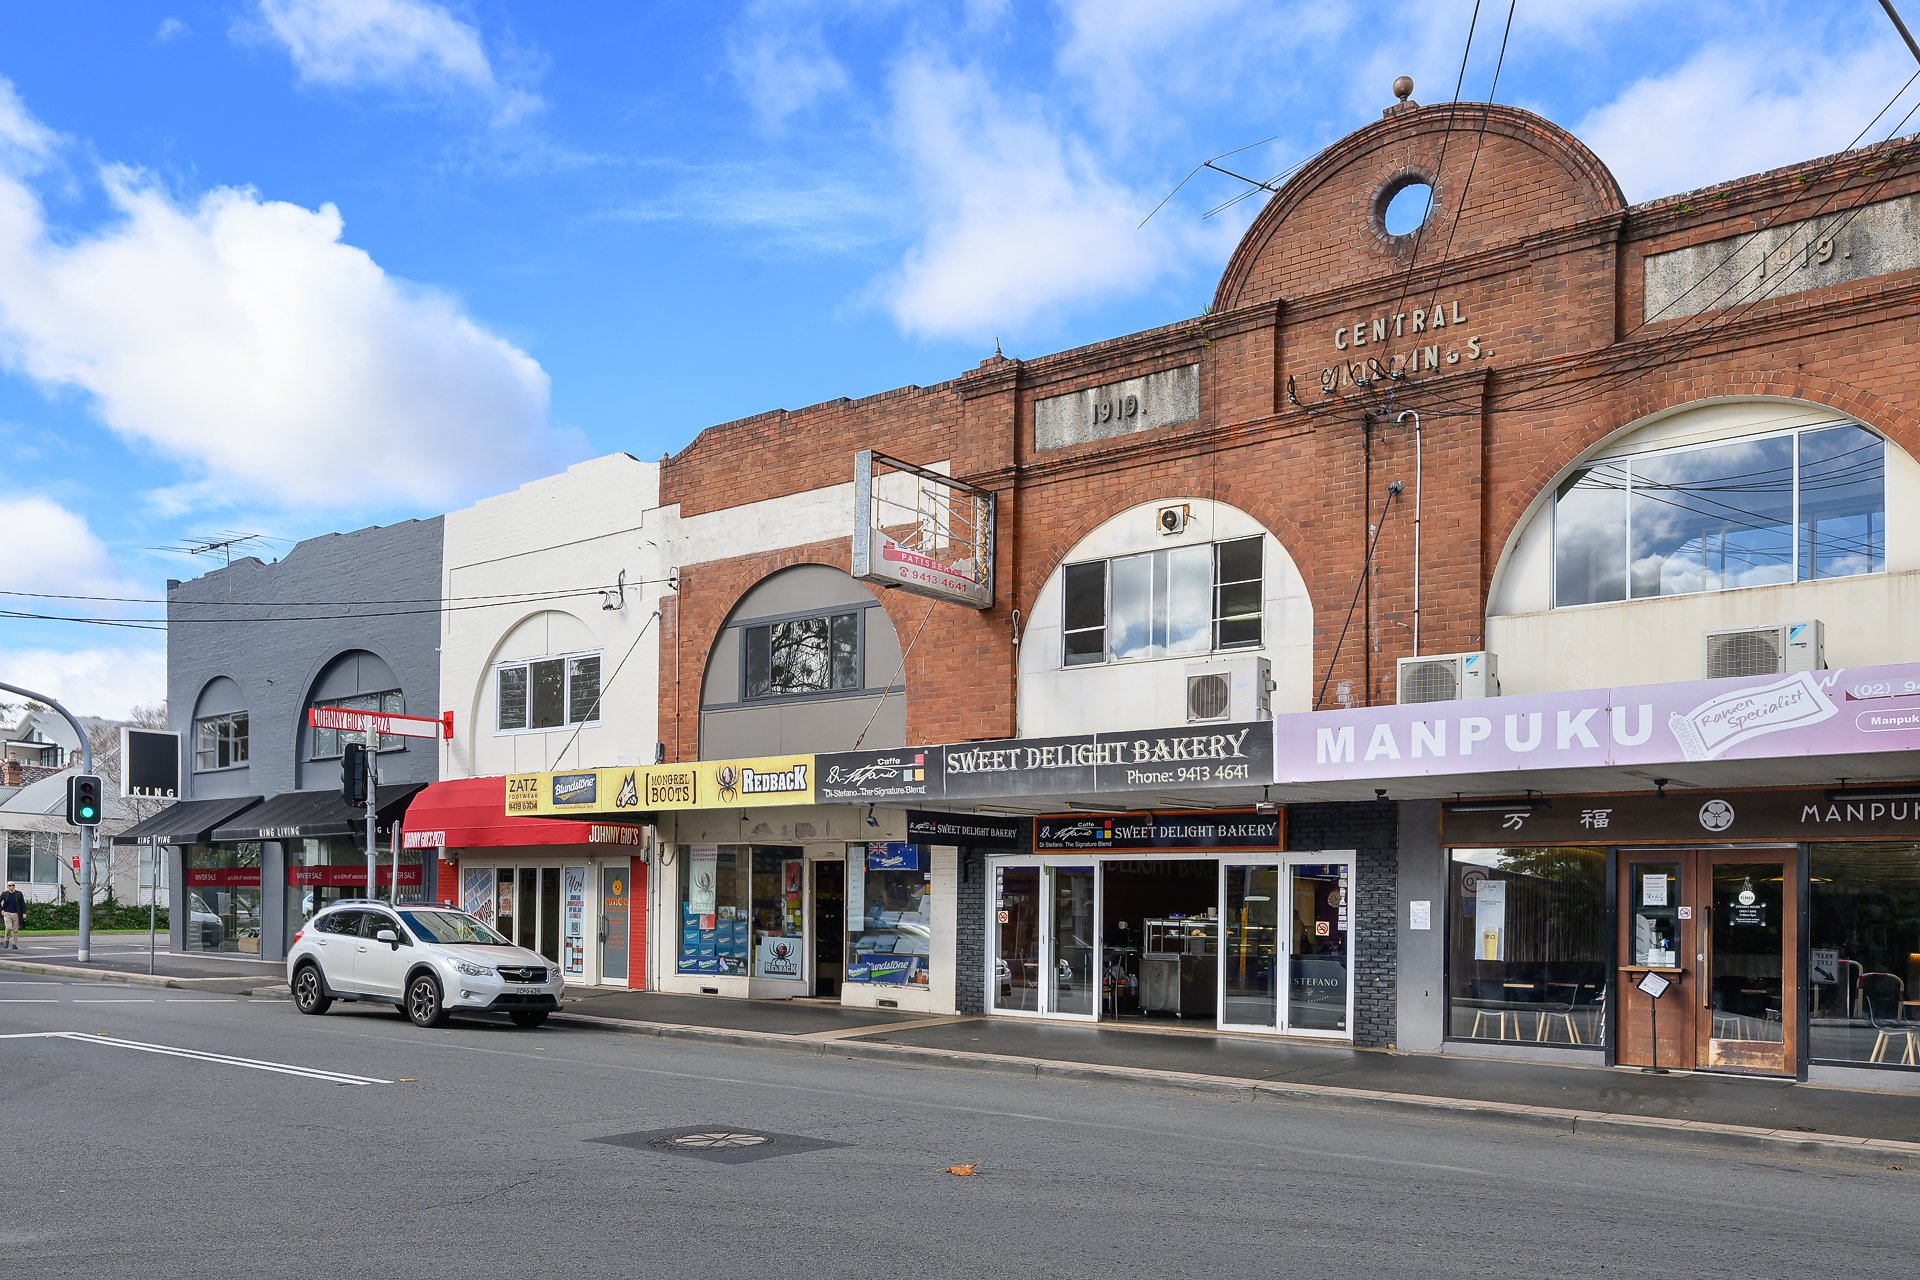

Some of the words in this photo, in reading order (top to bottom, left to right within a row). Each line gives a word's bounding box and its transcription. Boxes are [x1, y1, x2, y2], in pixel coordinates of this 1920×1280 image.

[1335, 301, 1467, 349] CENTRAL
[1093, 395, 1148, 425] 1919.
[911, 570, 938, 585] 9413
[940, 579, 967, 592] 4641
[1854, 682, 1891, 697] (02)
[1701, 699, 1755, 727] Ramen
[1727, 690, 1805, 731] Specialist
[314, 709, 345, 728] JOHNNY
[346, 713, 365, 730] GIO'S
[372, 716, 391, 733] PIZZA
[1316, 703, 1653, 764] MANPUKU
[946, 746, 1022, 774] SWEET
[1023, 743, 1131, 770] DELIGHT
[1132, 728, 1250, 763] BAKERY
[877, 757, 901, 766] Caffe
[651, 774, 690, 787] MONGREL
[742, 764, 808, 794] REDBACK
[1126, 768, 1175, 784] Phone:
[1177, 765, 1211, 782] 9413
[1214, 763, 1249, 780] 4641
[133, 786, 174, 798] KING
[509, 778, 538, 792] ZATZ
[555, 778, 596, 796] Blundstone
[652, 786, 690, 803] BOOTS
[259, 828, 275, 838] KING
[277, 826, 300, 837] LIVING
[588, 824, 620, 844] JOHNNY
[620, 827, 639, 846] GIO'S
[937, 824, 961, 834] SWEET
[962, 826, 990, 837] DELIGHT
[990, 829, 1018, 839] BAKERY
[1115, 825, 1157, 839] SWEET
[1160, 825, 1215, 838] DELIGHT
[1218, 822, 1278, 837] BAKERY
[137, 836, 150, 844] KING
[1075, 841, 1097, 849] Signature
[567, 871, 585, 893] Yo!
[1294, 977, 1338, 987] STEFANO
